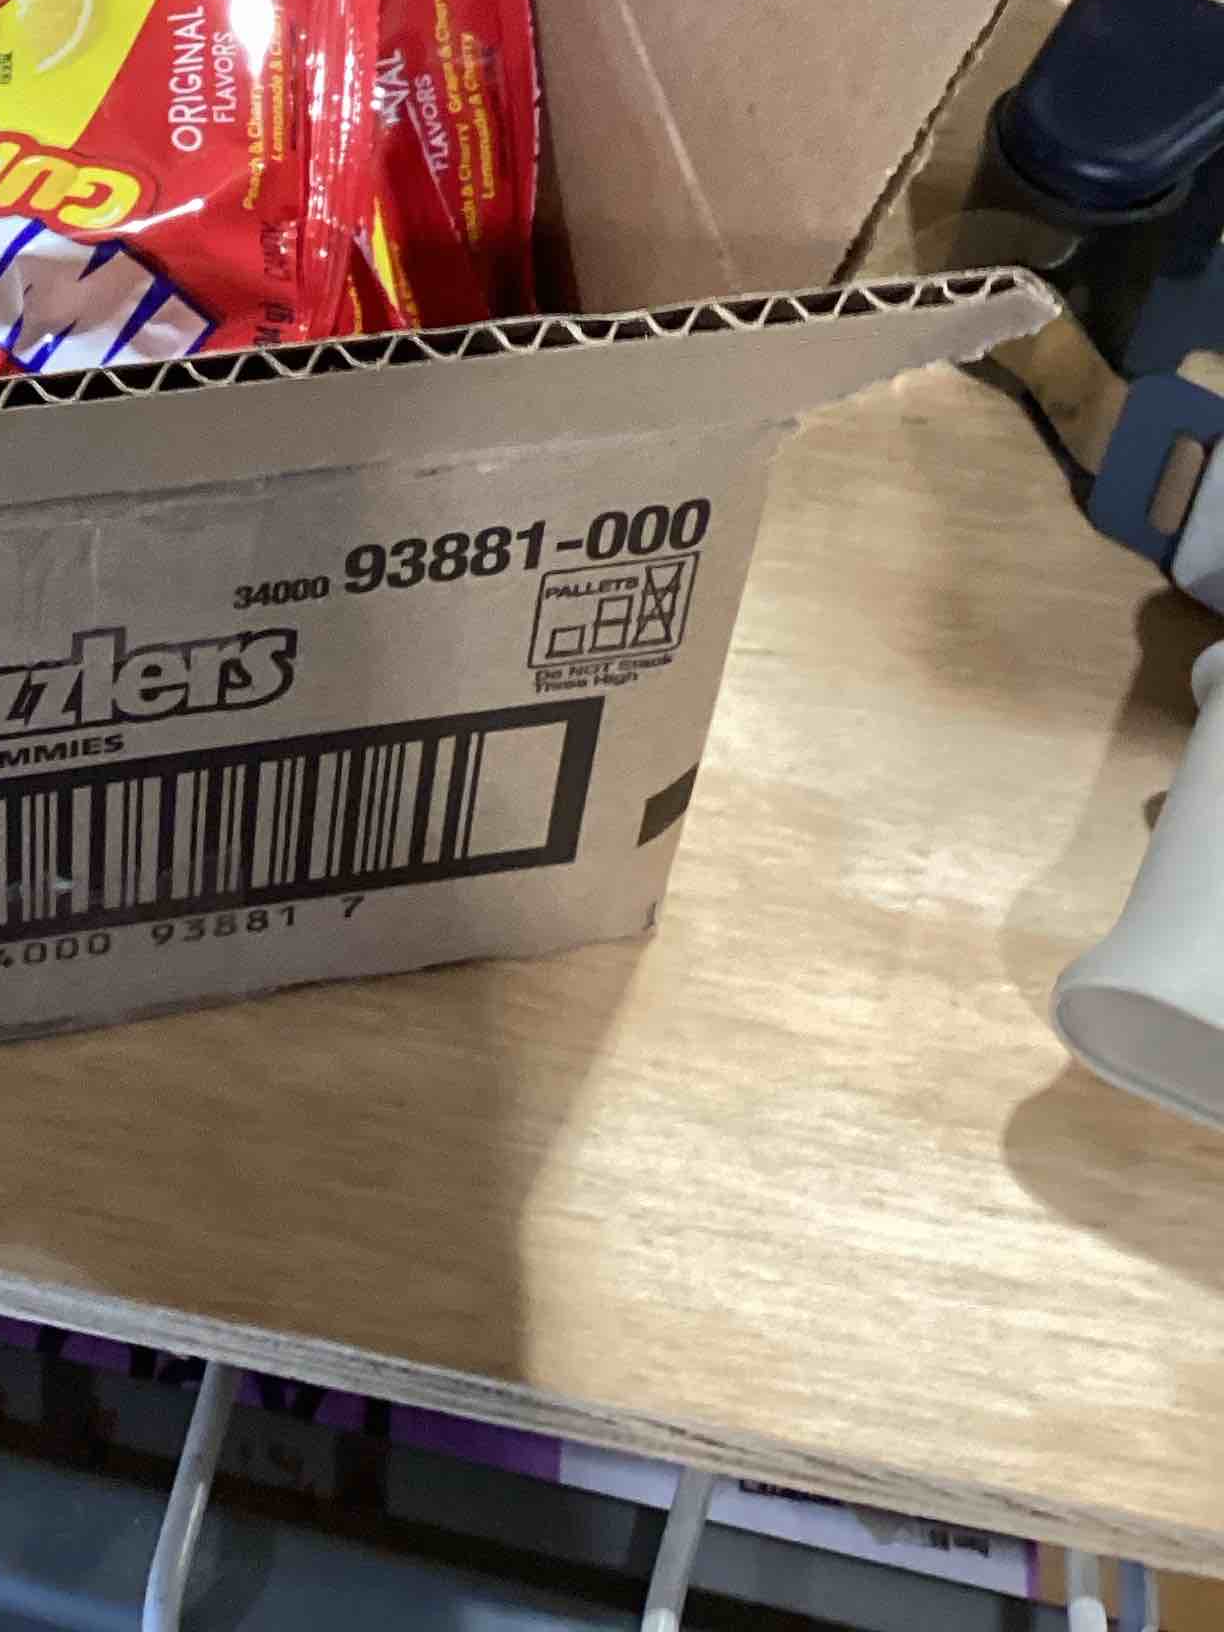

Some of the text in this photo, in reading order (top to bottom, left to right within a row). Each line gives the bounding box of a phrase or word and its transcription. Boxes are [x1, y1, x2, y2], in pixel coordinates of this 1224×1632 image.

[168, 5, 207, 152] ORIGINAL
[212, 31, 237, 123] FLAVORS
[414, 74, 450, 172] FLAVORS
[233, 498, 711, 610] 34000 93881-000
[544, 575, 640, 599] PALLETS
[150, 906, 297, 946] 93881
[341, 894, 365, 921] 7
